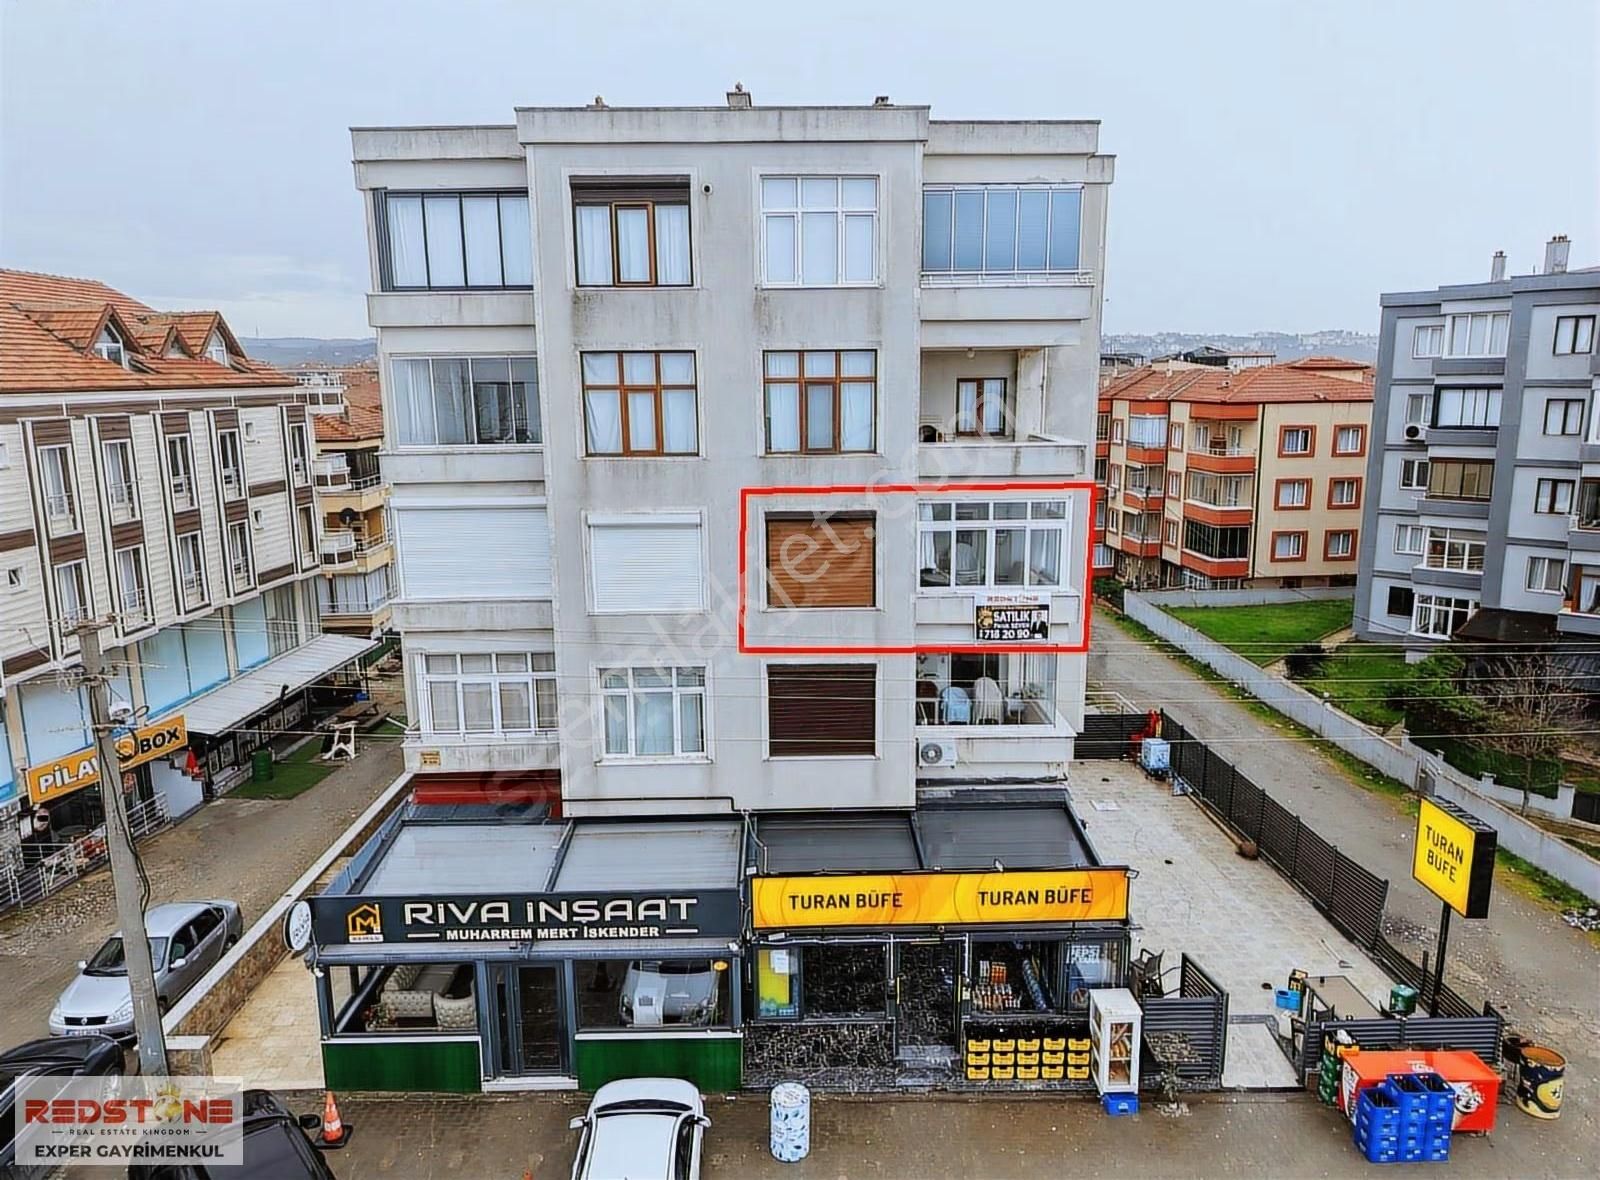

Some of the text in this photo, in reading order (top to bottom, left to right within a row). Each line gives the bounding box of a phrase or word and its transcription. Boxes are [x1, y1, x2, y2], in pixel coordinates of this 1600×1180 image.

[993, 610, 1030, 622] SATILIK
[140, 726, 181, 754] BOX
[1425, 825, 1464, 865] TURAN
[788, 889, 903, 910] TURAN BÜFE
[977, 885, 1093, 906] TURAN BÜFE
[446, 928, 533, 940] MUHARREM
[537, 927, 578, 939] MERT
